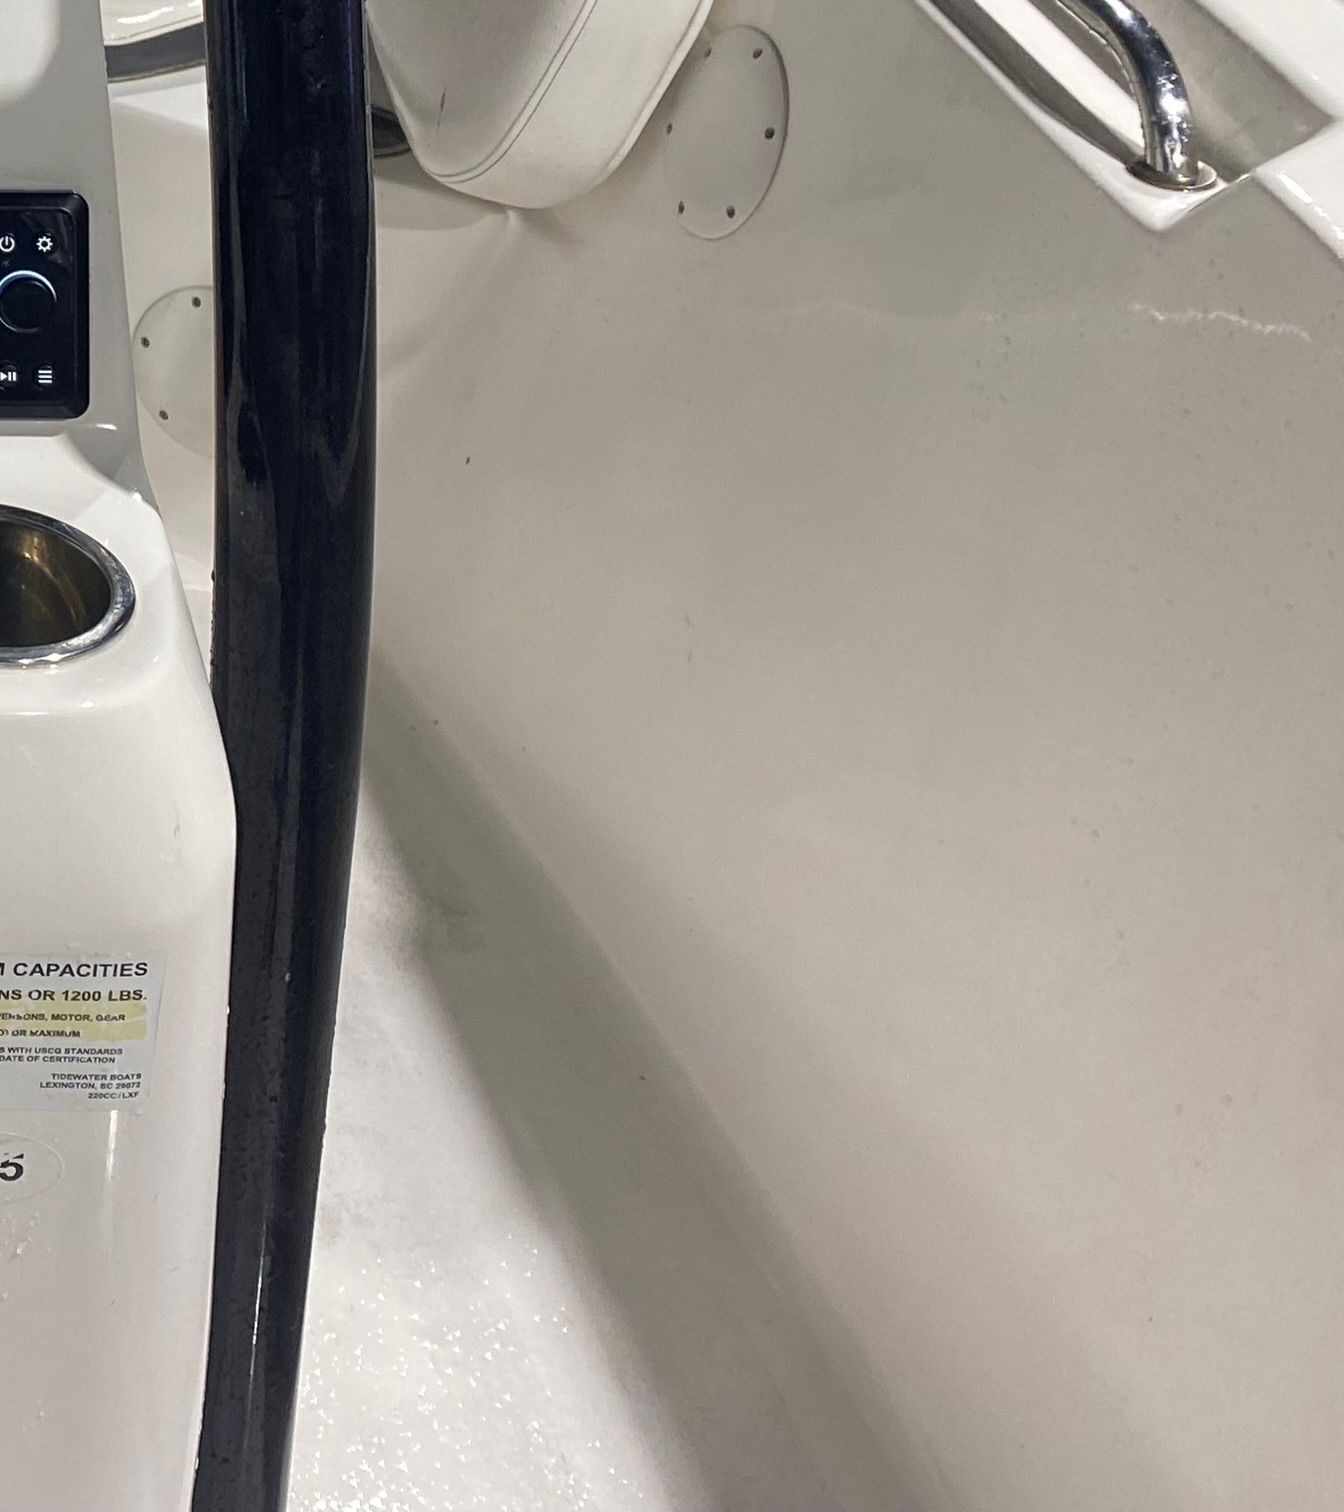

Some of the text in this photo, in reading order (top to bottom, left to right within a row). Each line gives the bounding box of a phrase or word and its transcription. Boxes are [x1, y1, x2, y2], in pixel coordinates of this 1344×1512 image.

[13, 962, 148, 978] CAPACITIES
[28, 989, 55, 1001] OR
[61, 989, 101, 1001] 1200
[108, 989, 147, 1002] LBS.
[51, 1013, 94, 1022] MOTOR,
[26, 1055, 40, 1063] OF
[42, 1056, 116, 1064] CERTIFICATION
[51, 1073, 107, 1081] TIDEWATER
[110, 1072, 142, 1081] BOATS
[39, 1081, 97, 1090] LEXINGTON,
[99, 1082, 113, 1090] SC
